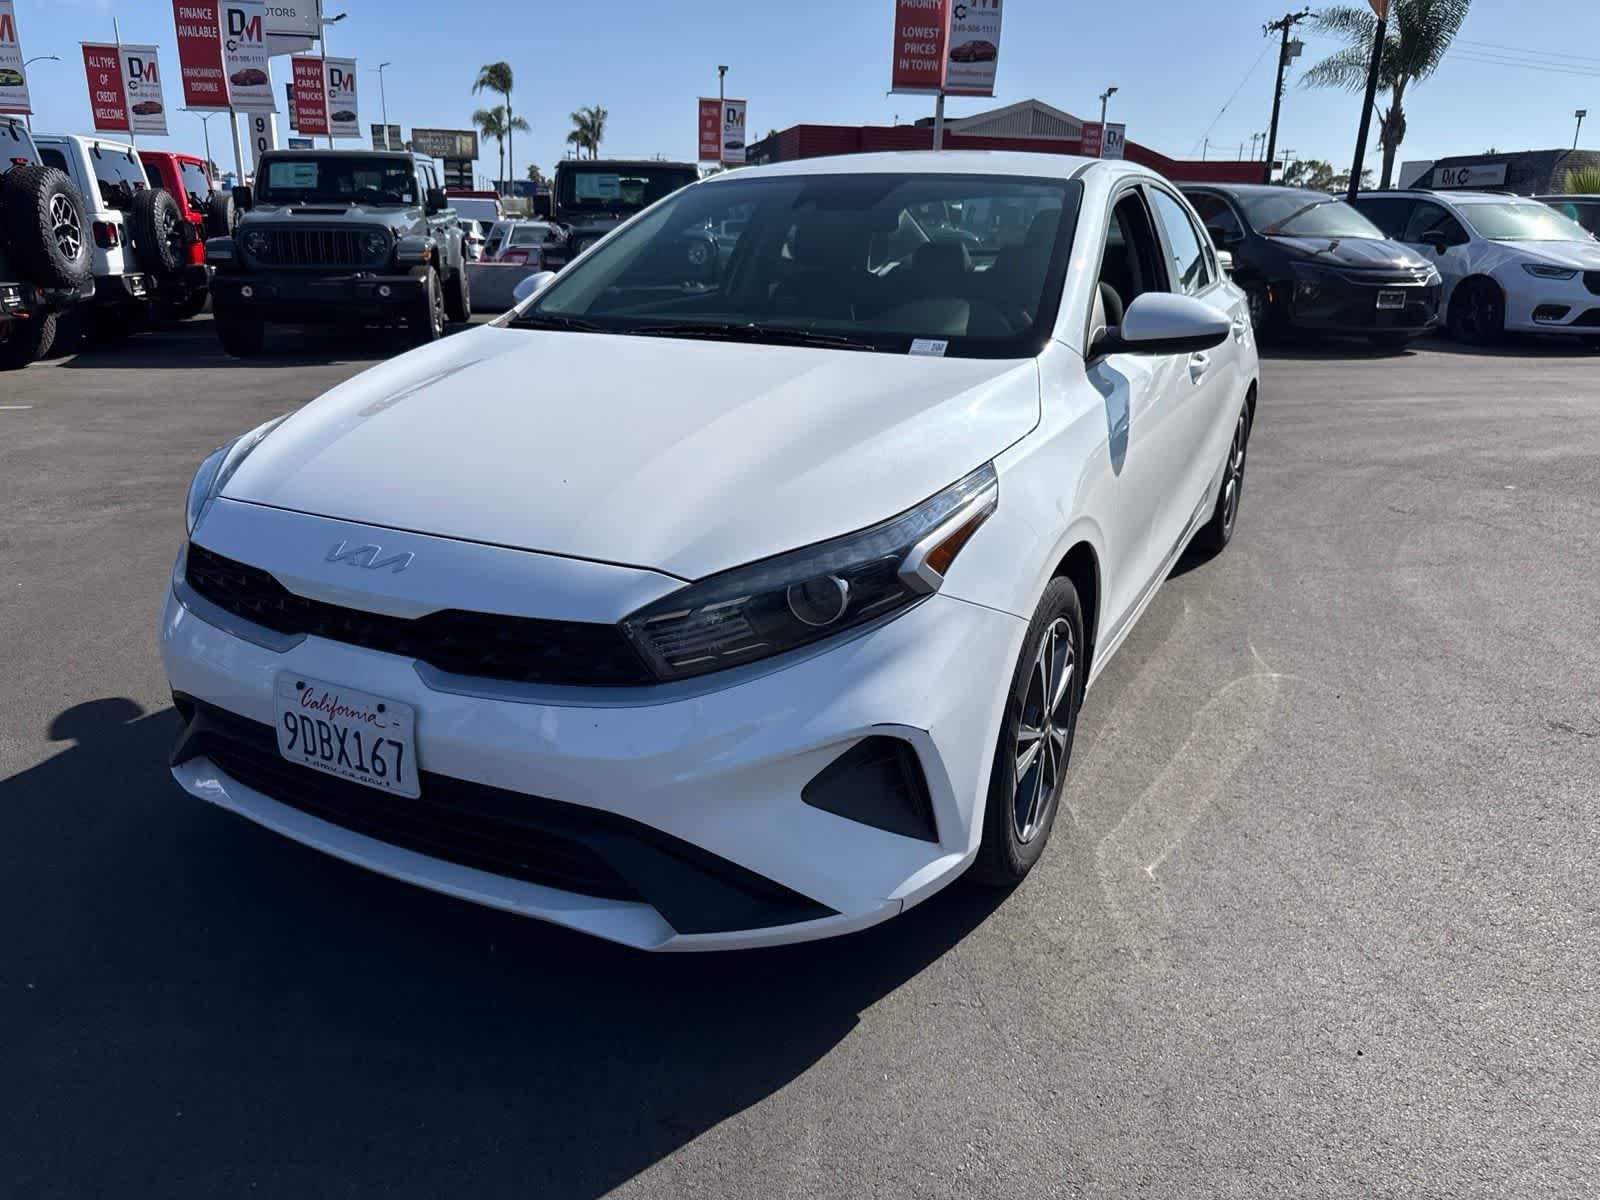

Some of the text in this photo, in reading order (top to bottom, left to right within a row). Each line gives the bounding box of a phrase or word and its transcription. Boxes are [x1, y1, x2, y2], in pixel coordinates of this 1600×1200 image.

[179, 7, 213, 20] FINANCE
[178, 25, 218, 38] AVAILABLE
[902, 26, 939, 39] LOWEST
[904, 42, 937, 54] PRICES
[89, 56, 116, 69] ALL TYPE
[899, 59, 939, 71] IN TOWN
[295, 66, 321, 76] WE BUY
[100, 74, 109, 85] OF
[297, 79, 315, 89] CARS
[96, 91, 118, 103] CREDIT
[297, 91, 323, 101] TRUCKS
[95, 109, 125, 120] WELCOME
[301, 687, 386, 729] California
[284, 711, 404, 783] 9DBX167
